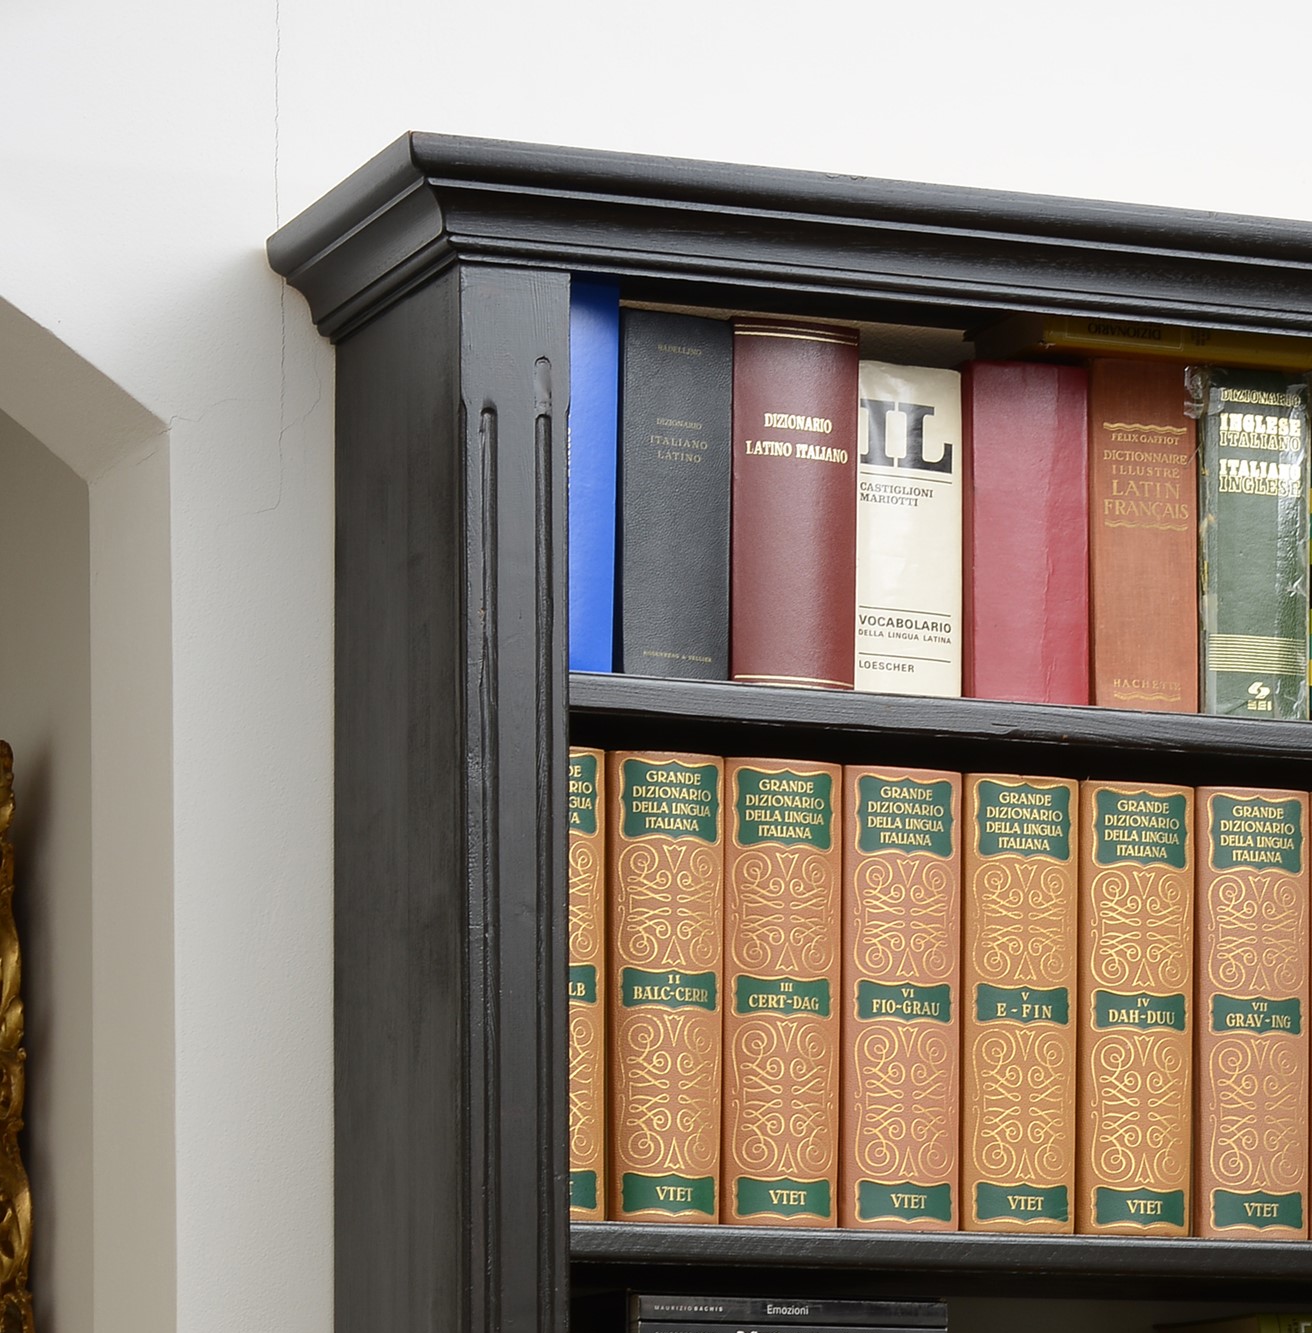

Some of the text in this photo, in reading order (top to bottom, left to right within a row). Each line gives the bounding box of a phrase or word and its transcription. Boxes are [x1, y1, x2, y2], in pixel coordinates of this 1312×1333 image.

[764, 413, 832, 433] DIZIONARIO
[859, 398, 953, 474] IL
[746, 440, 848, 464] LATINO ITALIANO
[1104, 449, 1187, 465] DICTIONNAIRE
[860, 482, 933, 498] CASTIGLIONI
[1112, 480, 1180, 499] LATIN
[860, 493, 918, 507] MARIOTTI
[1104, 499, 1188, 520] FRANÇAIS
[859, 614, 951, 633] VOCABOLARIO
[858, 628, 951, 644] DELLA LINGUA LATINA
[859, 660, 915, 673] LOESCHER
[646, 770, 701, 785] GRANDE
[633, 786, 711, 801] DIZIONARIO
[633, 801, 711, 818] DELLA LINGUA
[645, 817, 699, 832] ITALIANA
[633, 986, 708, 1002] BALC-CERR
[871, 999, 940, 1016] FIO-GRAU
[1109, 1008, 1175, 1024] DAH-DUU
[767, 1304, 809, 1315] Emozioni
